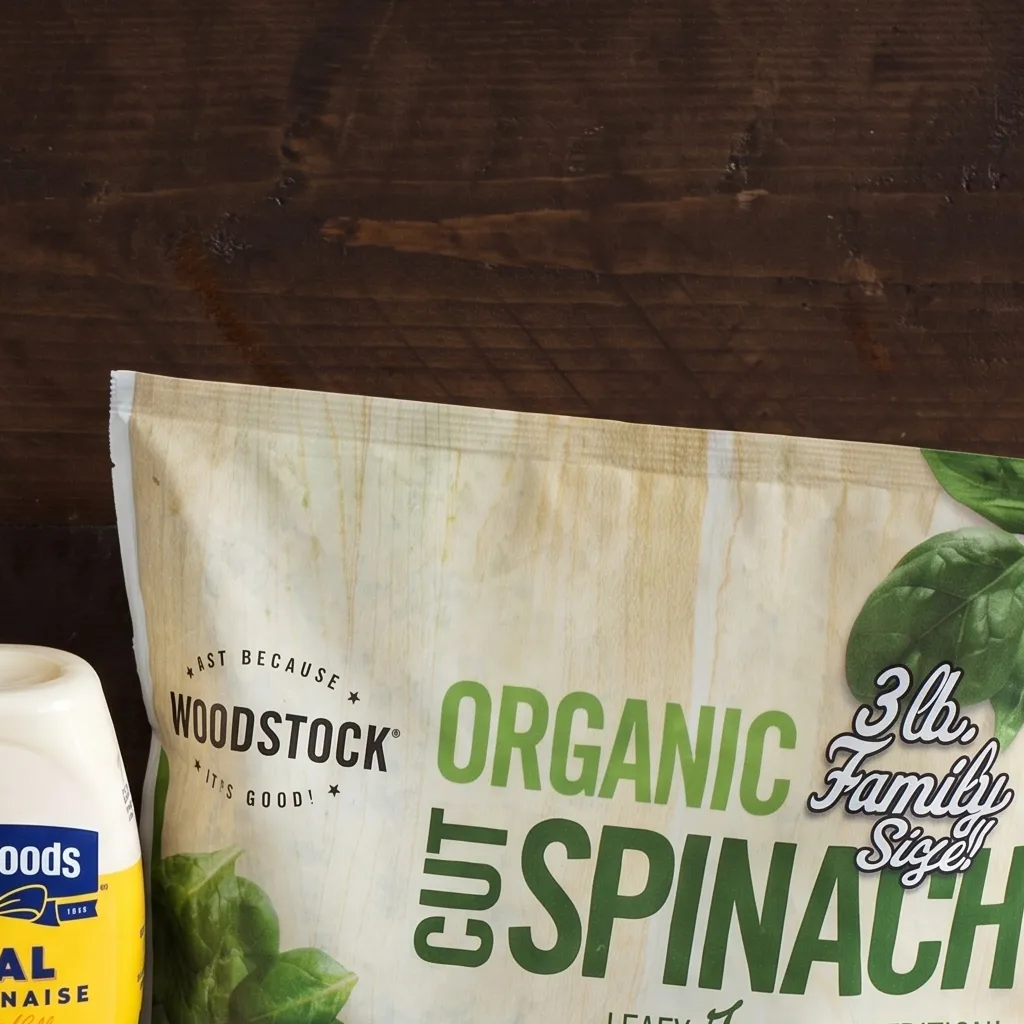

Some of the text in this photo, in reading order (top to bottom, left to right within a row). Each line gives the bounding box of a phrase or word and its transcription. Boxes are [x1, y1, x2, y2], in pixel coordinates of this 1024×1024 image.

[242, 650, 340, 690] BECAUSE
[853, 665, 912, 738] 3
[170, 691, 391, 772] WOODSTOCK
[437, 680, 797, 816] ORGANIC
[246, 789, 314, 808] GOOD!
[807, 734, 1014, 840] Family
[413, 807, 508, 968] CUT
[508, 818, 1024, 997] SPINACH
